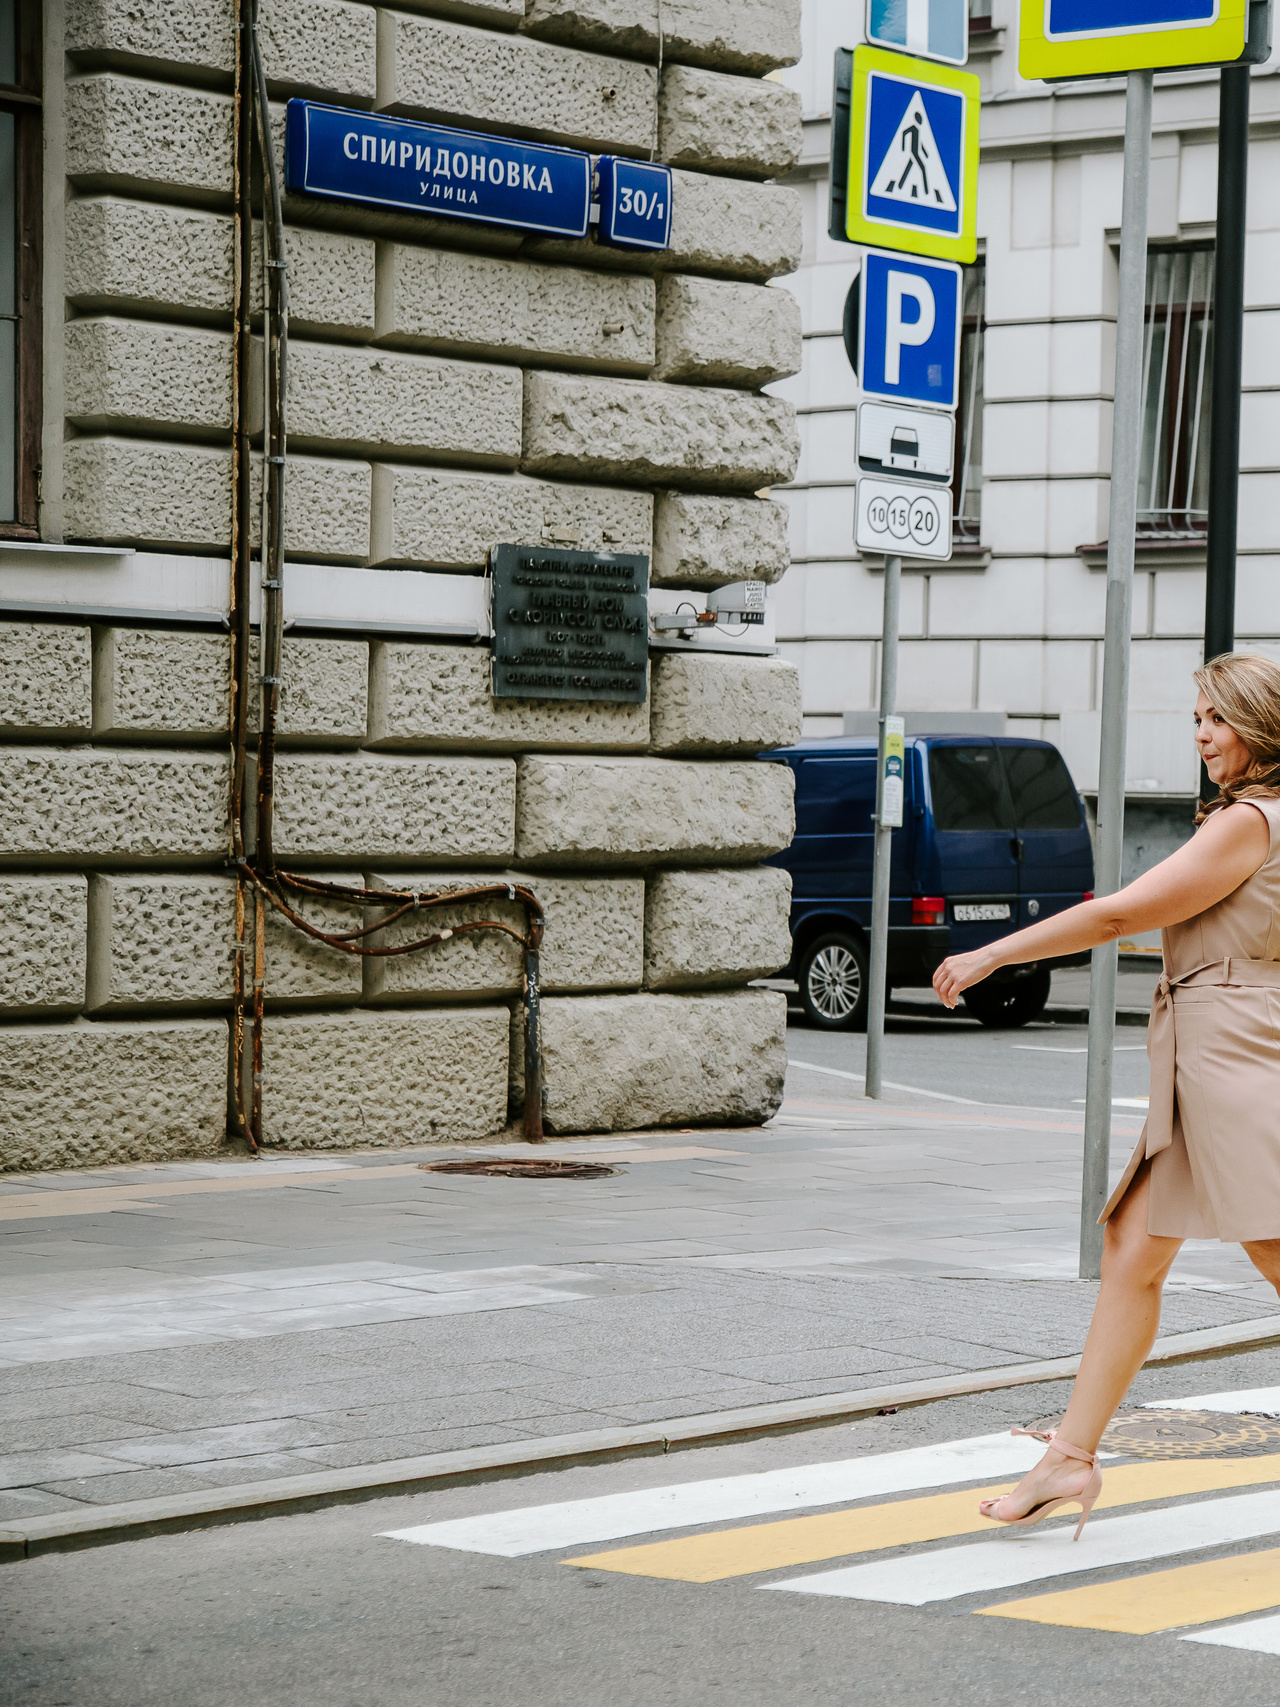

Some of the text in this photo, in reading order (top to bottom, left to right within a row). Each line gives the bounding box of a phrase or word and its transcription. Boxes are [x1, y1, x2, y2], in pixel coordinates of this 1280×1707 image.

[342, 131, 554, 195] СПИРИДОНОВКА
[420, 182, 479, 205] УЛИЦА
[618, 186, 665, 222] 30/1
[884, 269, 936, 386] P
[872, 507, 934, 532] 10 15 20
[594, 597, 624, 612] ДОМ
[509, 608, 520, 621] С
[525, 610, 597, 627] КОРПУСОМ
